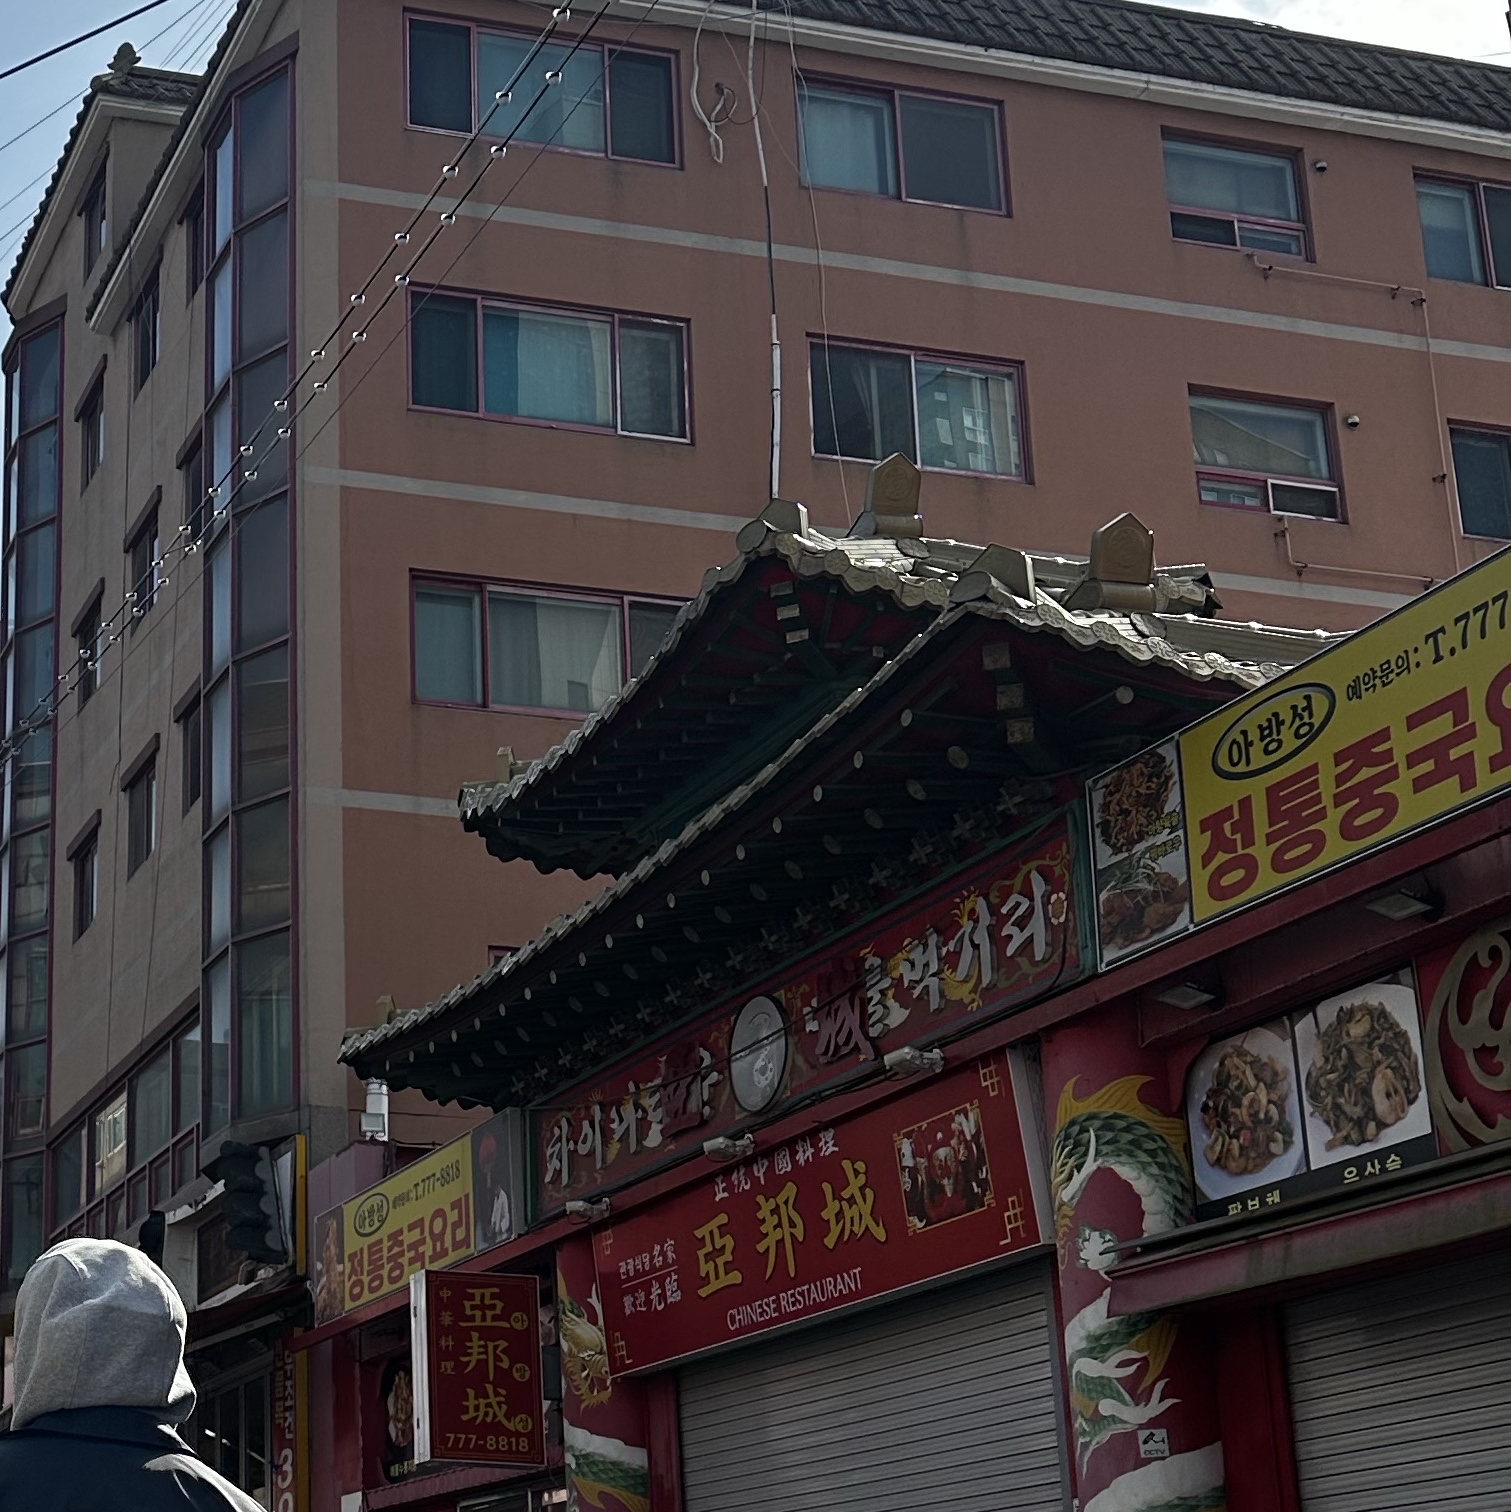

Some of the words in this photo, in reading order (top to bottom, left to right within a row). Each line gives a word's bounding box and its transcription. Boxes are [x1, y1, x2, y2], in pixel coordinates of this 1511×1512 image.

[1346, 650, 1419, 701] 예약문의:
[1226, 692, 1317, 769] 아방성
[414, 1159, 461, 1201] T.777-8818
[714, 1128, 839, 1201] 正統中國料理
[347, 1192, 472, 1303] 정통중국요리
[357, 1199, 384, 1231] 아방성
[694, 1159, 887, 1298] 亞邦城
[727, 1296, 778, 1331] CHINESE
[781, 1267, 863, 1316] RESTAURANT
[458, 1287, 516, 1432] 亞邦城
[445, 1434, 530, 1453] 777-8818
